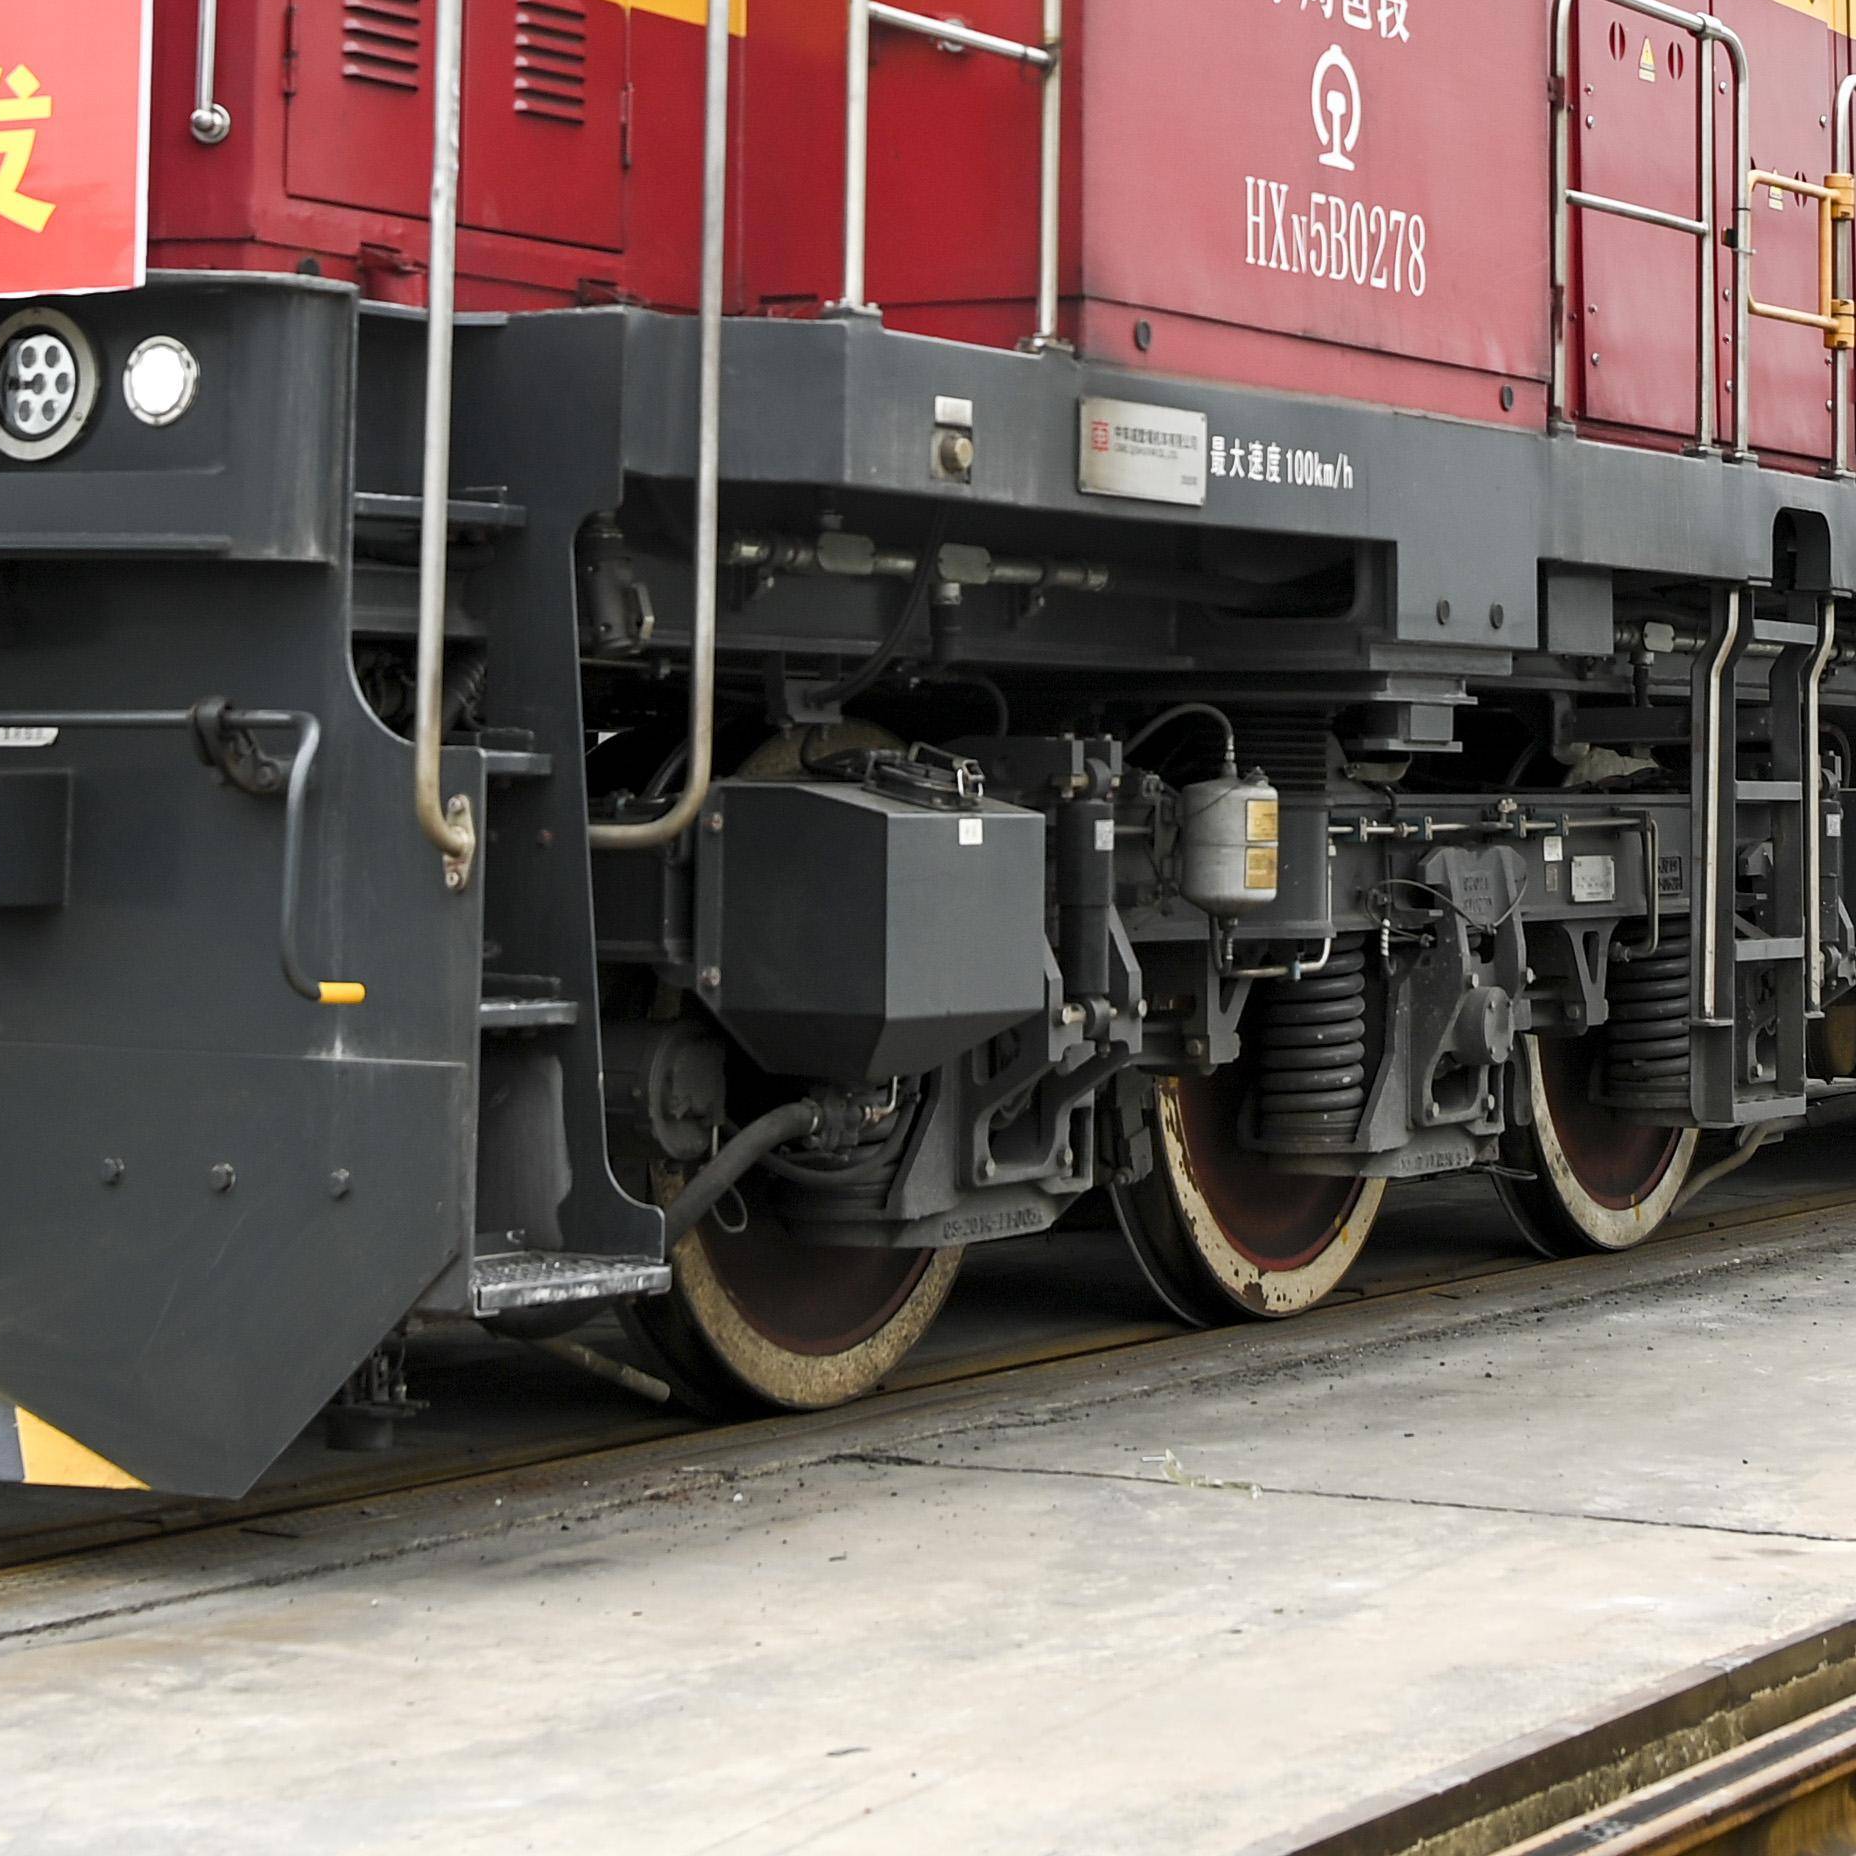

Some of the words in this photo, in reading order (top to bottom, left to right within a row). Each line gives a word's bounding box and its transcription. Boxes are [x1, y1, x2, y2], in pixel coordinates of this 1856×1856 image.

[1209, 435, 1282, 484] 最大速度
[1286, 448, 1354, 489] 100km/h
